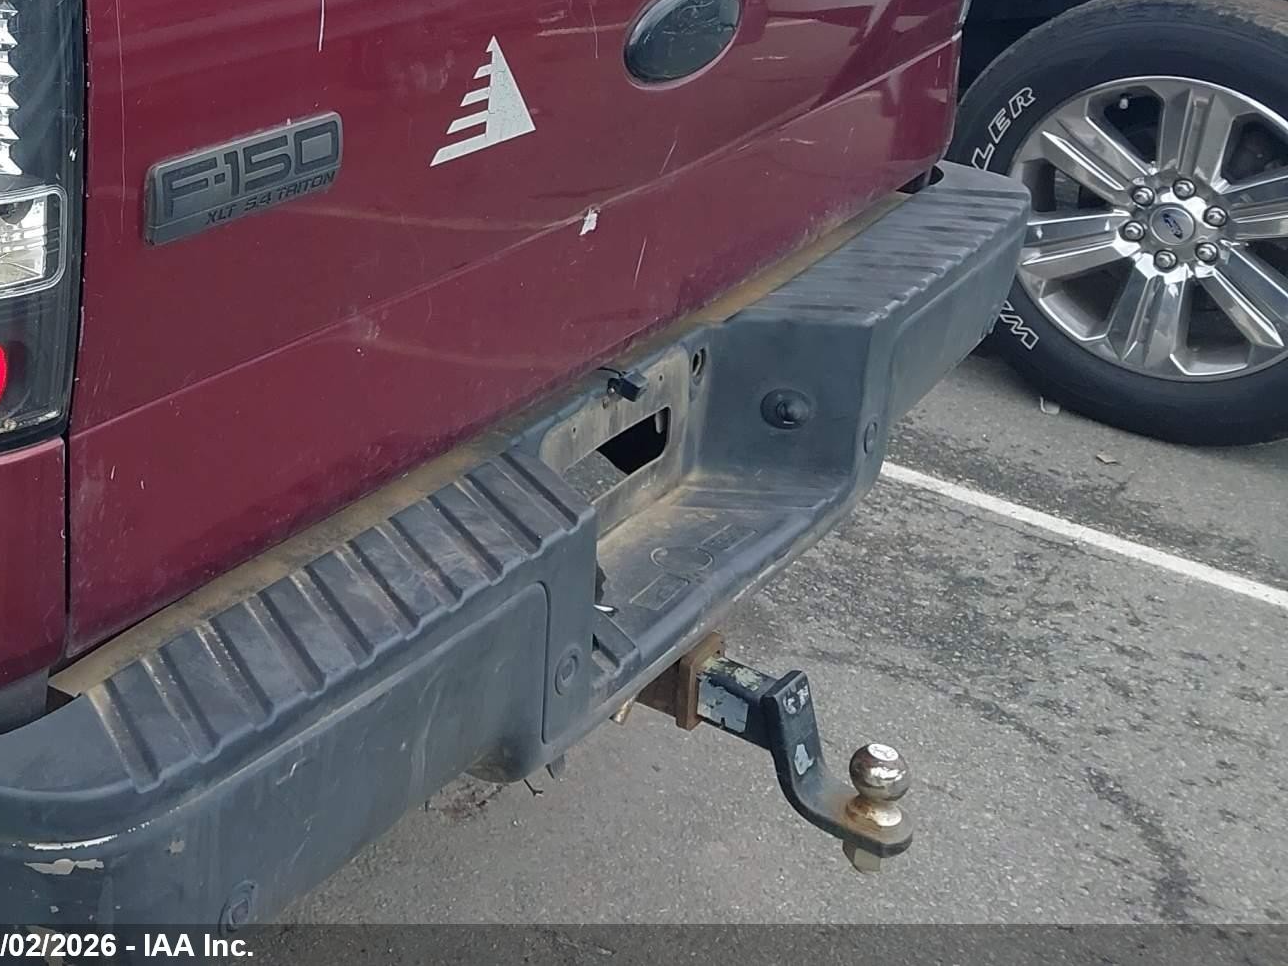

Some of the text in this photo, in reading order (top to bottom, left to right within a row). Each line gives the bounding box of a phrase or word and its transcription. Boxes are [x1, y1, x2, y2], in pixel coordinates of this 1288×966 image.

[162, 120, 339, 218] F-150
[205, 203, 237, 225] XLT
[276, 170, 336, 201] TRITON
